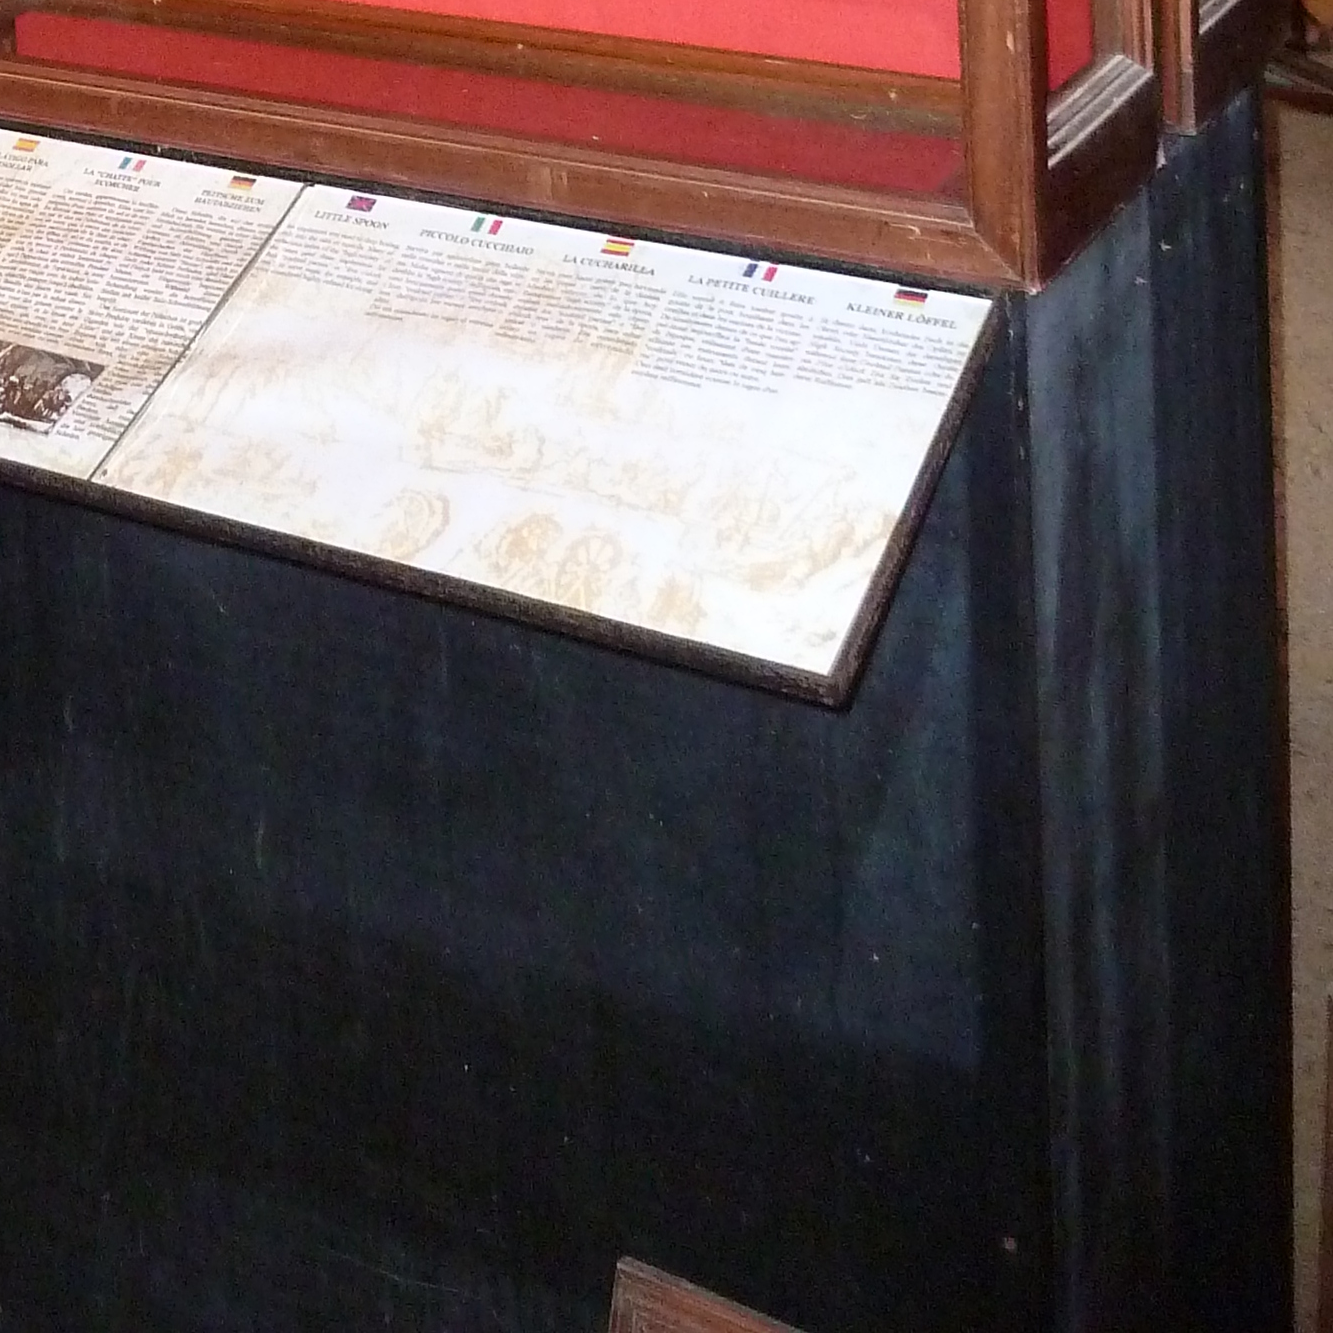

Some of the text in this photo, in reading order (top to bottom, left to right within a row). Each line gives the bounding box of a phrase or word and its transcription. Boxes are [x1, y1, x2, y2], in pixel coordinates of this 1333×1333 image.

[83, 167, 95, 176] LA
[314, 210, 390, 230] LITTLE SPOON
[419, 229, 534, 256] PICCOLO CUCCHIAIO
[562, 254, 656, 276] LA CUCHARILLA
[688, 275, 815, 305] LA PETITE CUILLERE
[846, 302, 958, 330] KLEINER LÖFFEL
